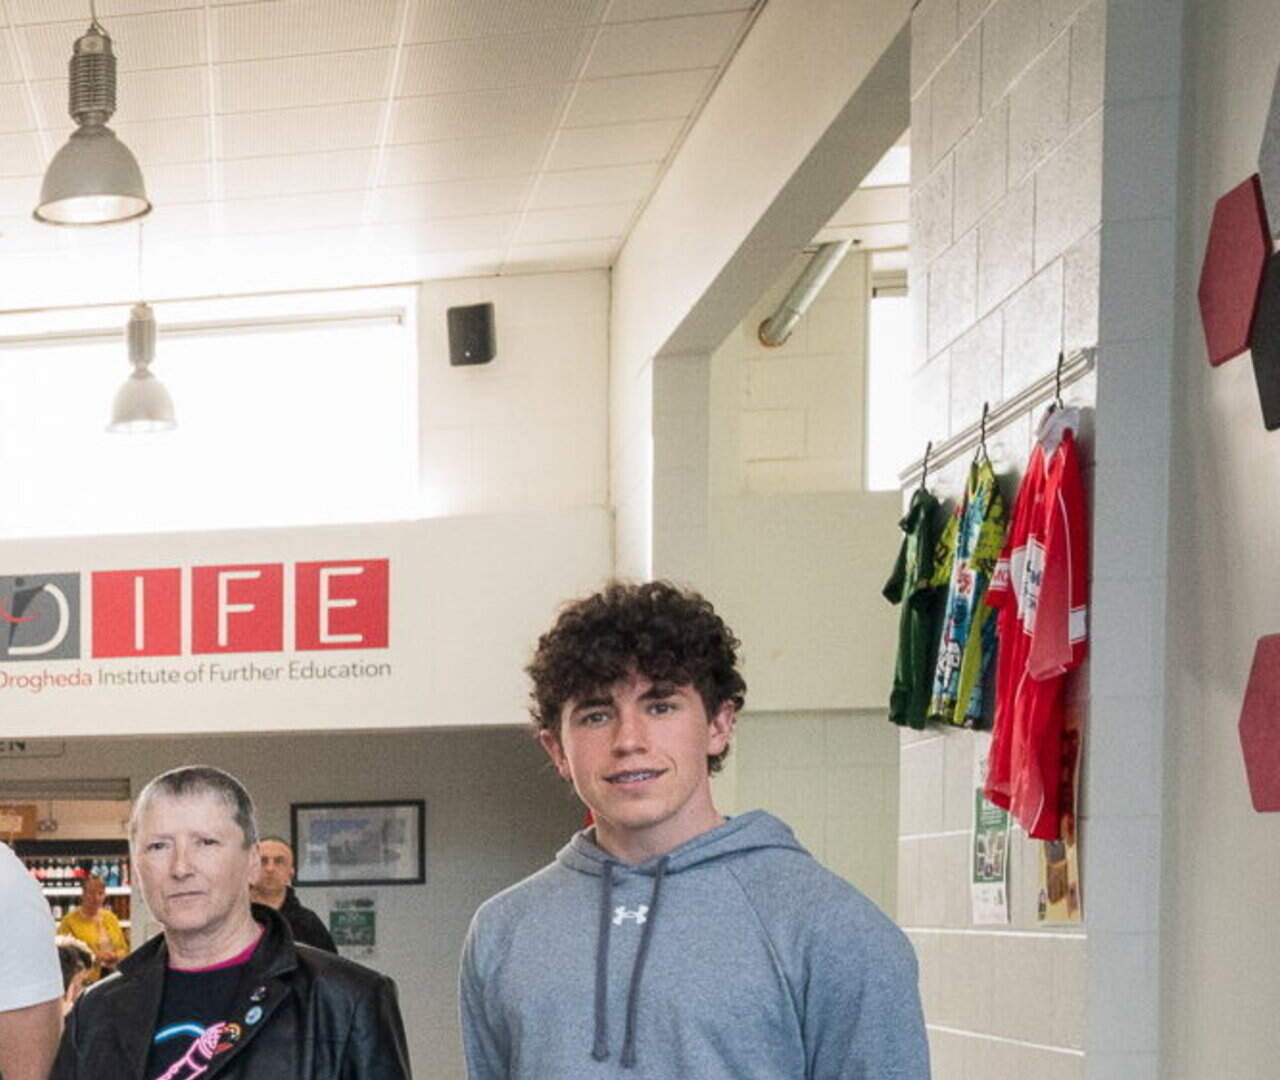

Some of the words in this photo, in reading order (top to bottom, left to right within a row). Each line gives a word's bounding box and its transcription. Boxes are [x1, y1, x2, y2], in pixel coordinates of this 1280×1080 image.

[8, 567, 365, 656] DIFE
[98, 667, 180, 686] Institute
[184, 664, 207, 684] of
[209, 663, 281, 684] Further
[288, 660, 391, 681] Education
